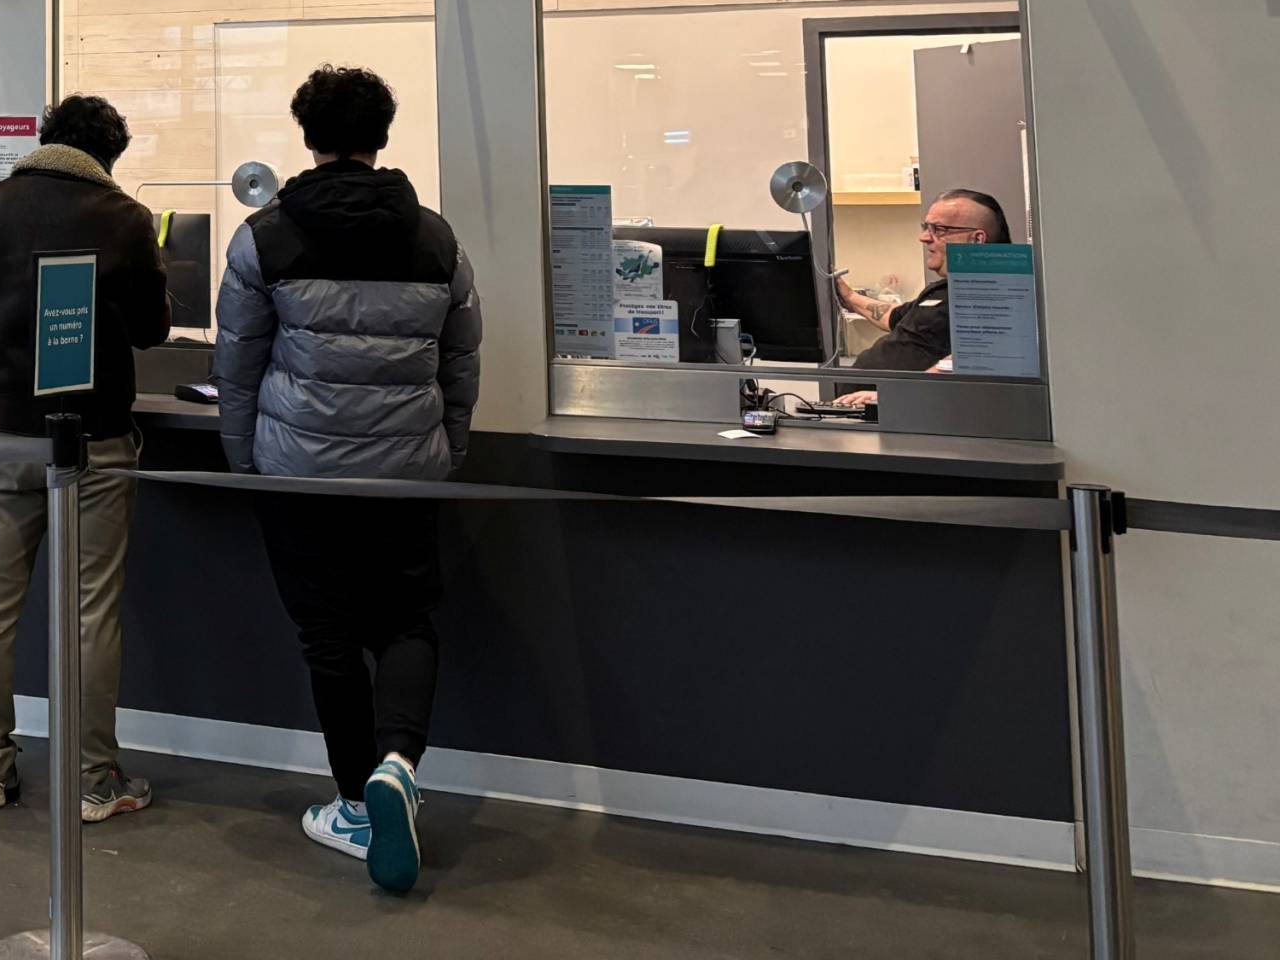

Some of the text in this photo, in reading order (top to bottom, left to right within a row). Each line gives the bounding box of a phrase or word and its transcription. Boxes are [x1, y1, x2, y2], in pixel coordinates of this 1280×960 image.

[44, 305, 88, 317] Avez-vous pris
[49, 320, 82, 331] un numéro
[53, 336, 59, 345] la
[60, 336, 78, 345] borne
